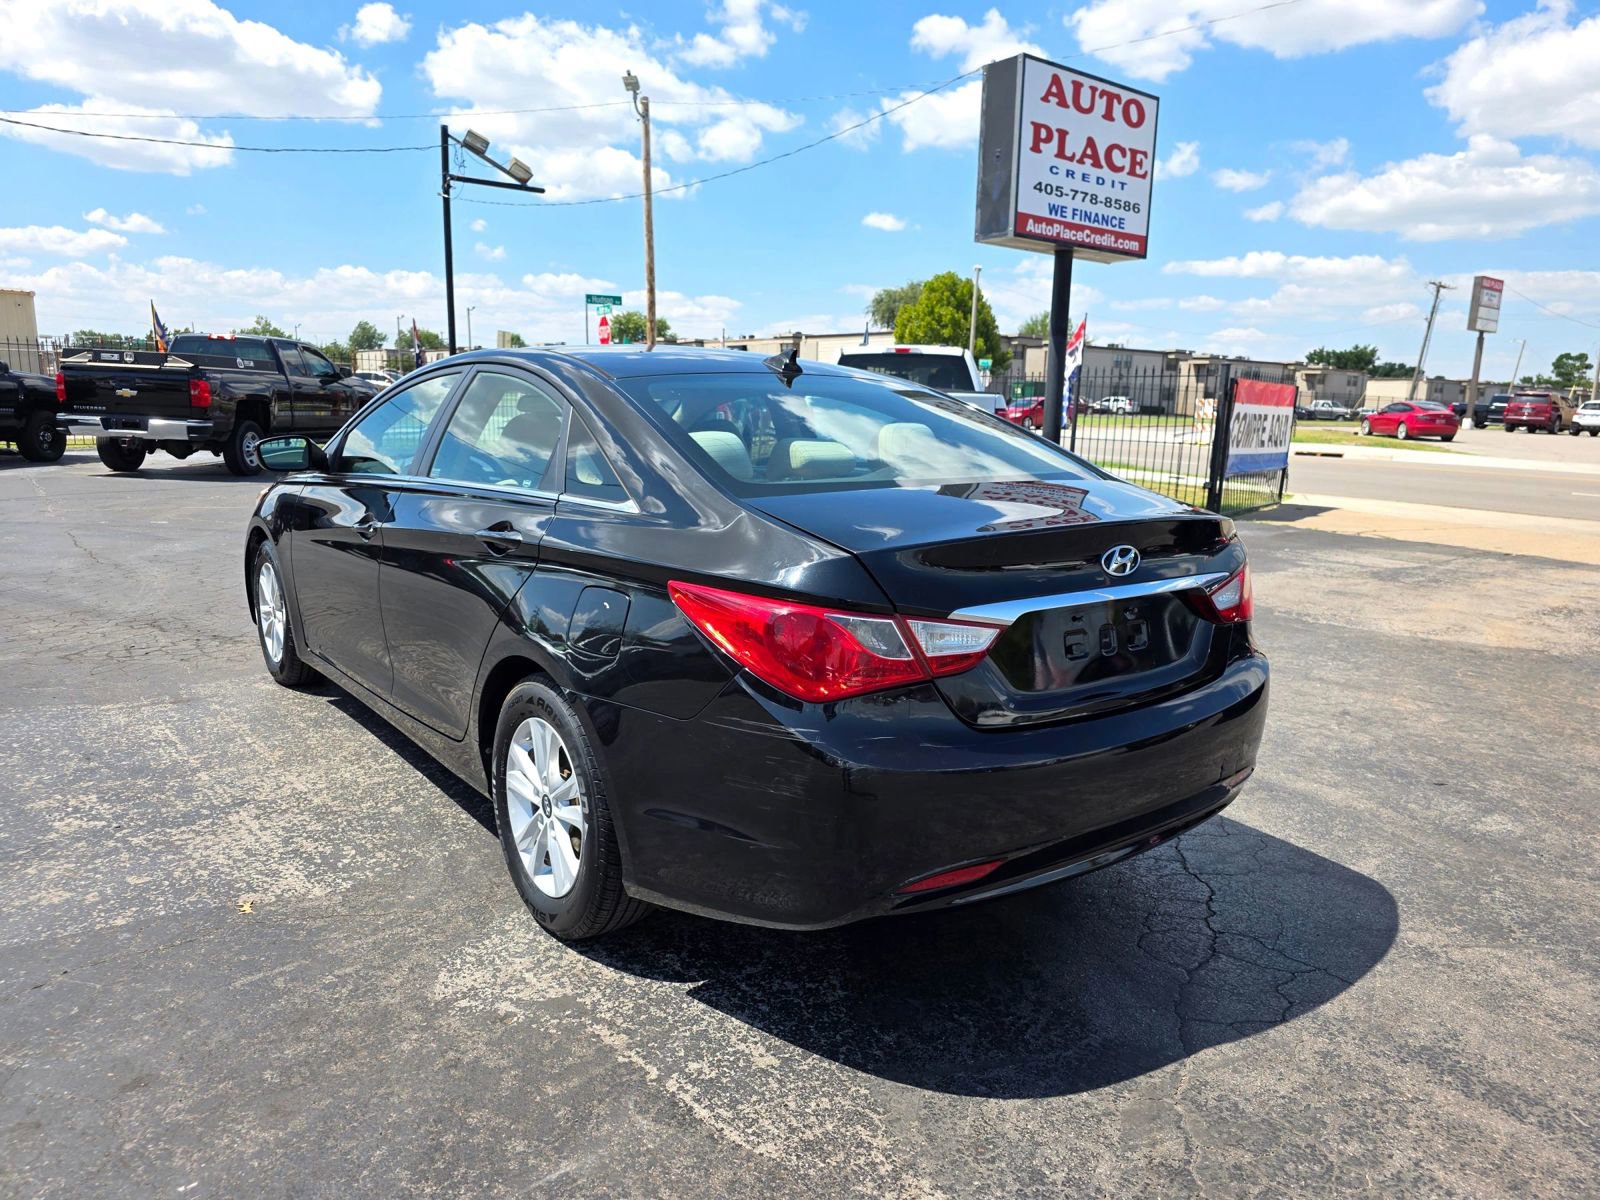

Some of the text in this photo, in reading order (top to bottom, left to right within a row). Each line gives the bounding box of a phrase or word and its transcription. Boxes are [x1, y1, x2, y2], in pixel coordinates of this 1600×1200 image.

[1040, 73, 1145, 129] AUTO
[1029, 121, 1148, 180] PLACE
[1049, 165, 1128, 191] CREDIT
[1033, 181, 1141, 214] 405-778-8586
[1048, 203, 1125, 230] WE FINANCE
[1026, 218, 1139, 251] AutoPlaceCredit.com
